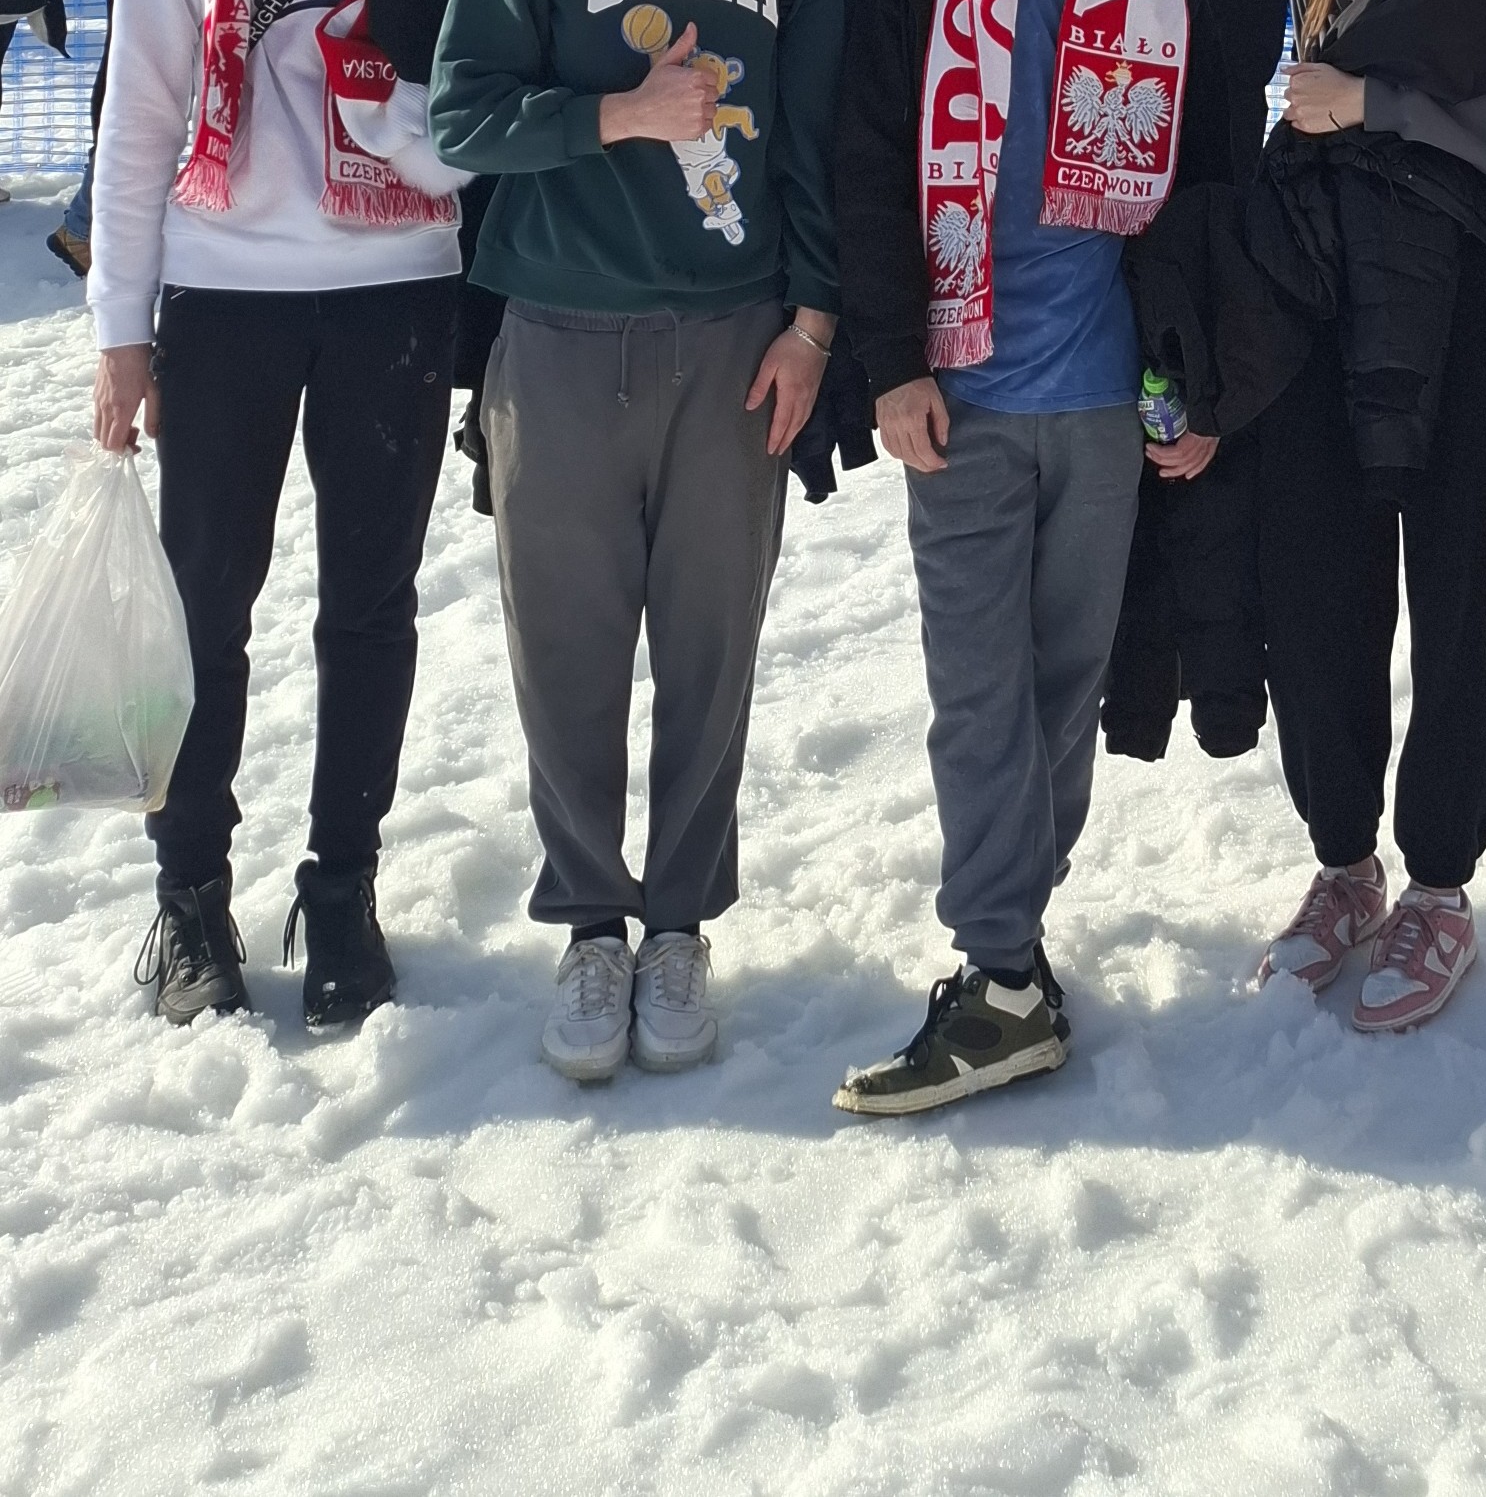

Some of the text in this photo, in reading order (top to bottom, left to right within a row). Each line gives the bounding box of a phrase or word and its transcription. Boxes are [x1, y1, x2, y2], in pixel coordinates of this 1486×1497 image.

[1069, 25, 1177, 59] BIAŁO
[342, 58, 397, 81] OLSKA
[340, 160, 401, 185] CZERW
[1057, 166, 1153, 197] CZERWONI
